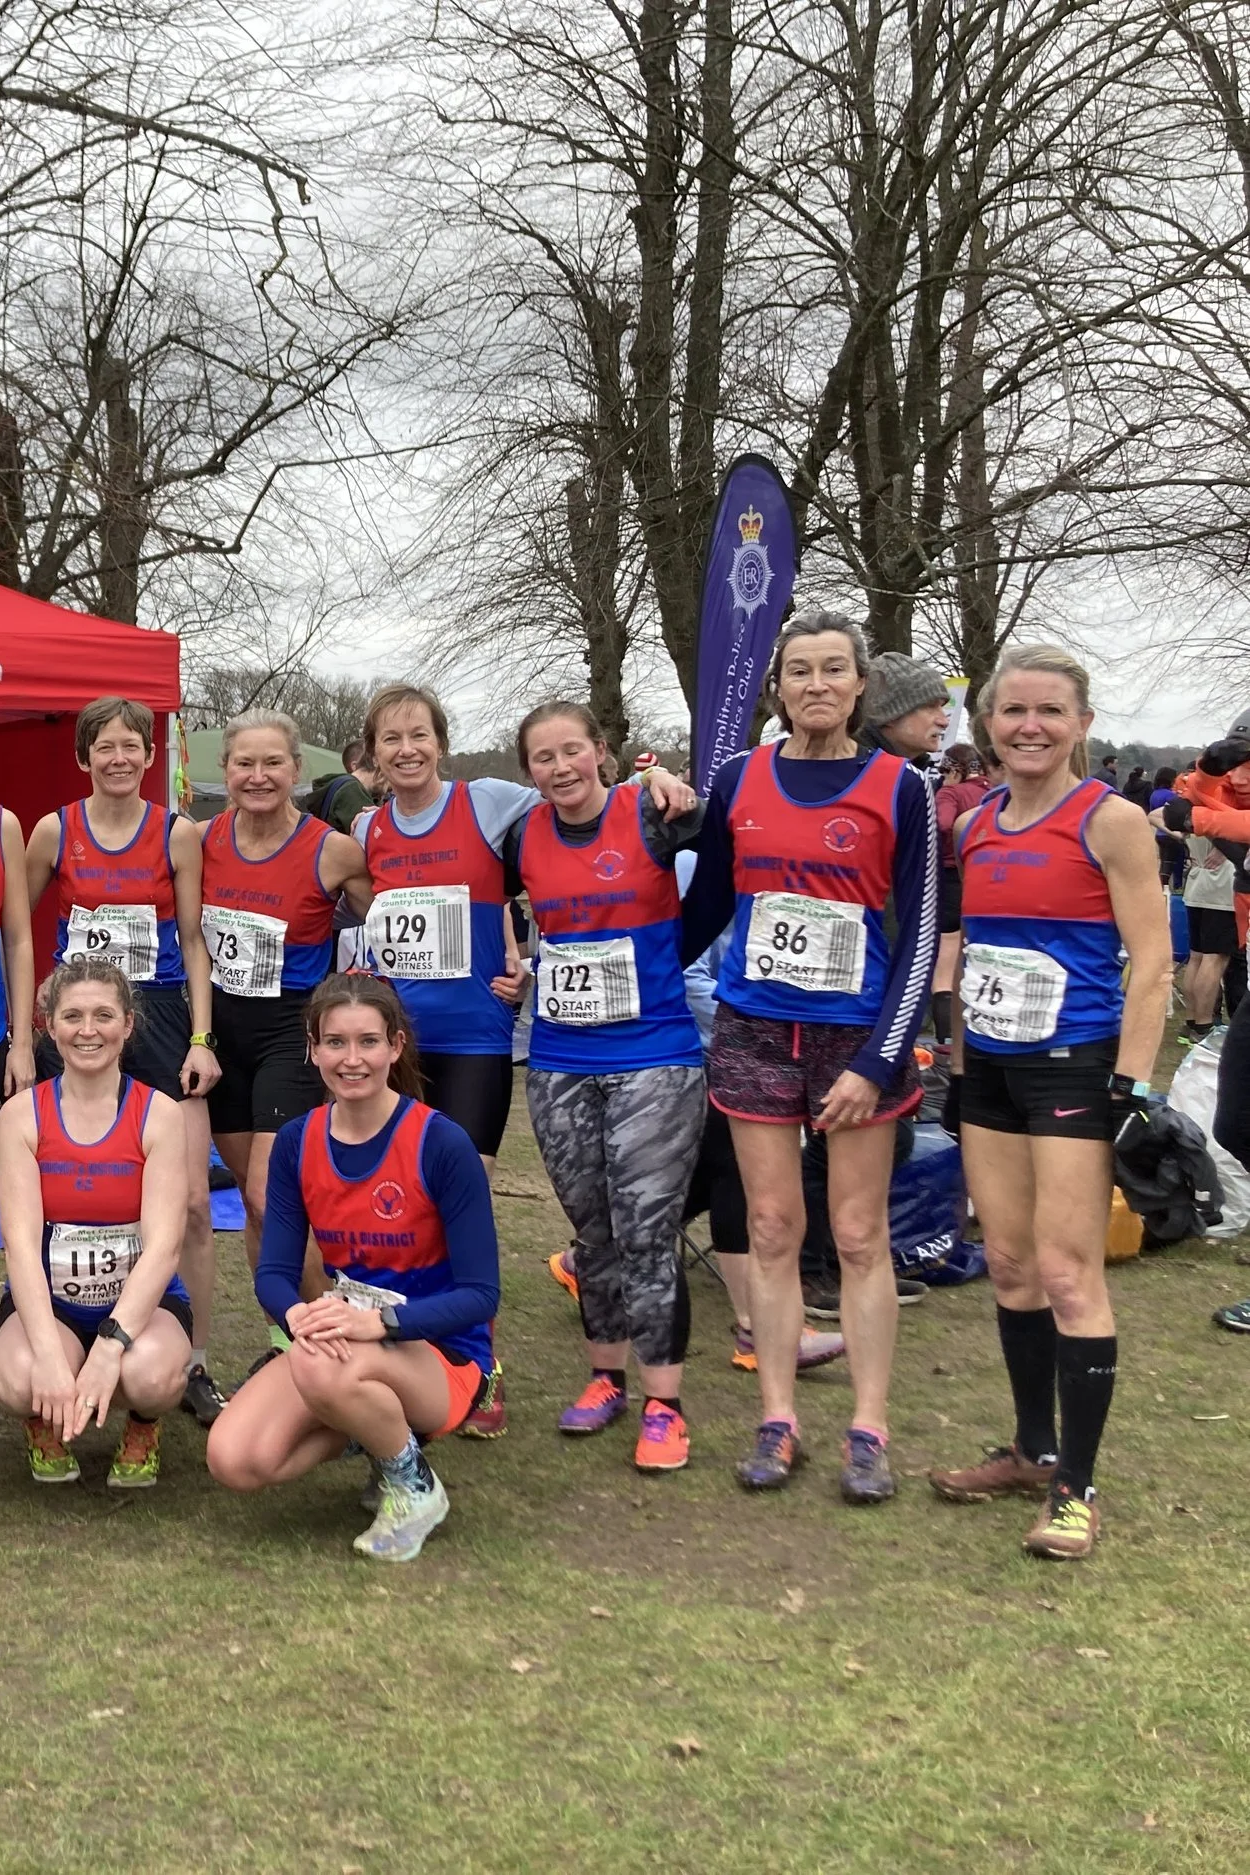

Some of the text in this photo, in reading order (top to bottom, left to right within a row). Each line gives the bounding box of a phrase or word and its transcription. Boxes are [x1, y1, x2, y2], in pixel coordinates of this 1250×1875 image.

[719, 656, 754, 766] hletics Club
[702, 684, 734, 800] Metropolitan
[409, 890, 434, 898] Cross
[381, 898, 447, 908] Country League
[107, 914, 137, 923] League
[219, 909, 234, 918] Met
[385, 913, 427, 944] 129
[86, 927, 111, 950] 69
[216, 930, 238, 960] 73
[772, 921, 808, 955] 86
[397, 951, 434, 962] START
[397, 962, 433, 970] FITNESS
[775, 960, 820, 976] START
[551, 964, 592, 992] 122
[975, 973, 1004, 1006] 76
[561, 1000, 600, 1011] START
[561, 1011, 599, 1019] FITNESS
[359, 1231, 417, 1247] DISTRICT
[71, 1249, 117, 1277] 113
[83, 1279, 125, 1292] START
